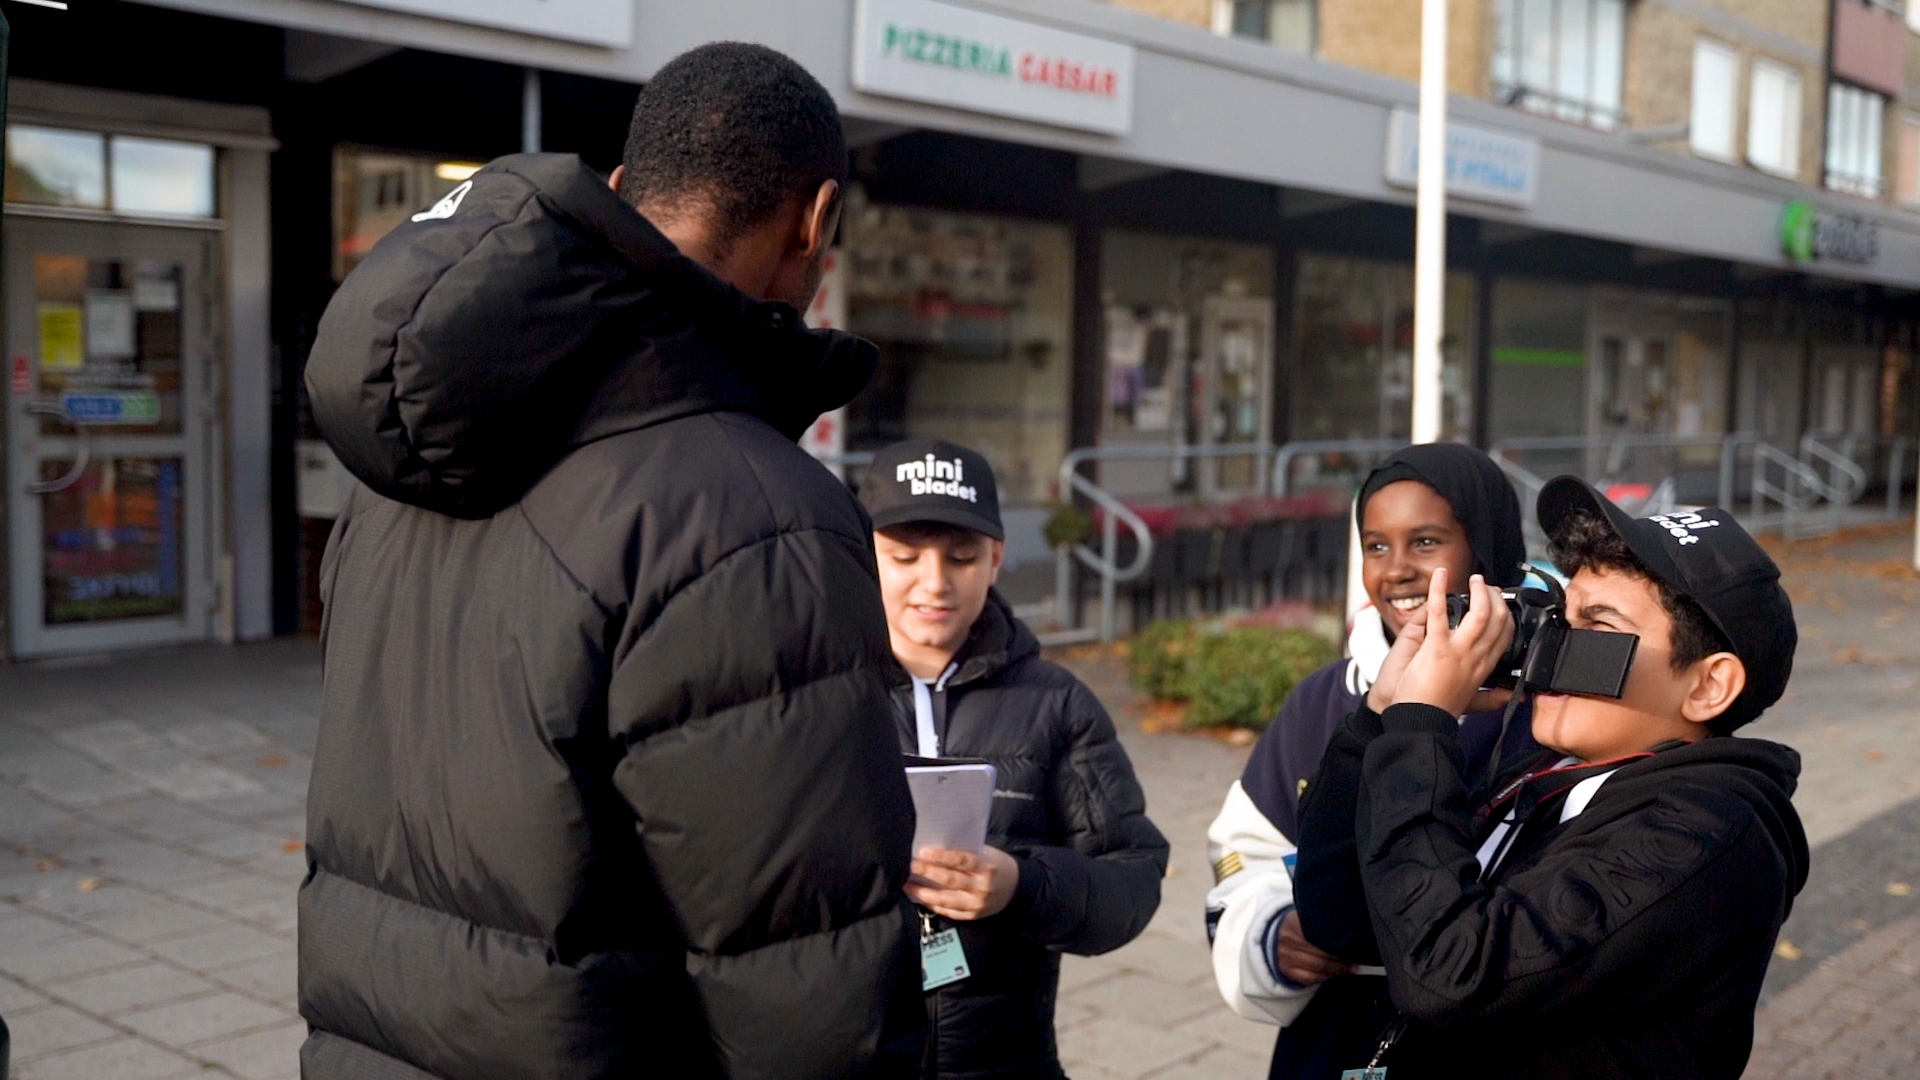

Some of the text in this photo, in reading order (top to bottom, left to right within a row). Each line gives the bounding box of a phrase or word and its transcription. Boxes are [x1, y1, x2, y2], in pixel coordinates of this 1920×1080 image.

[882, 23, 1117, 99] PIZZERIA CAESAR
[896, 453, 963, 482] mini
[911, 476, 977, 503] bladet
